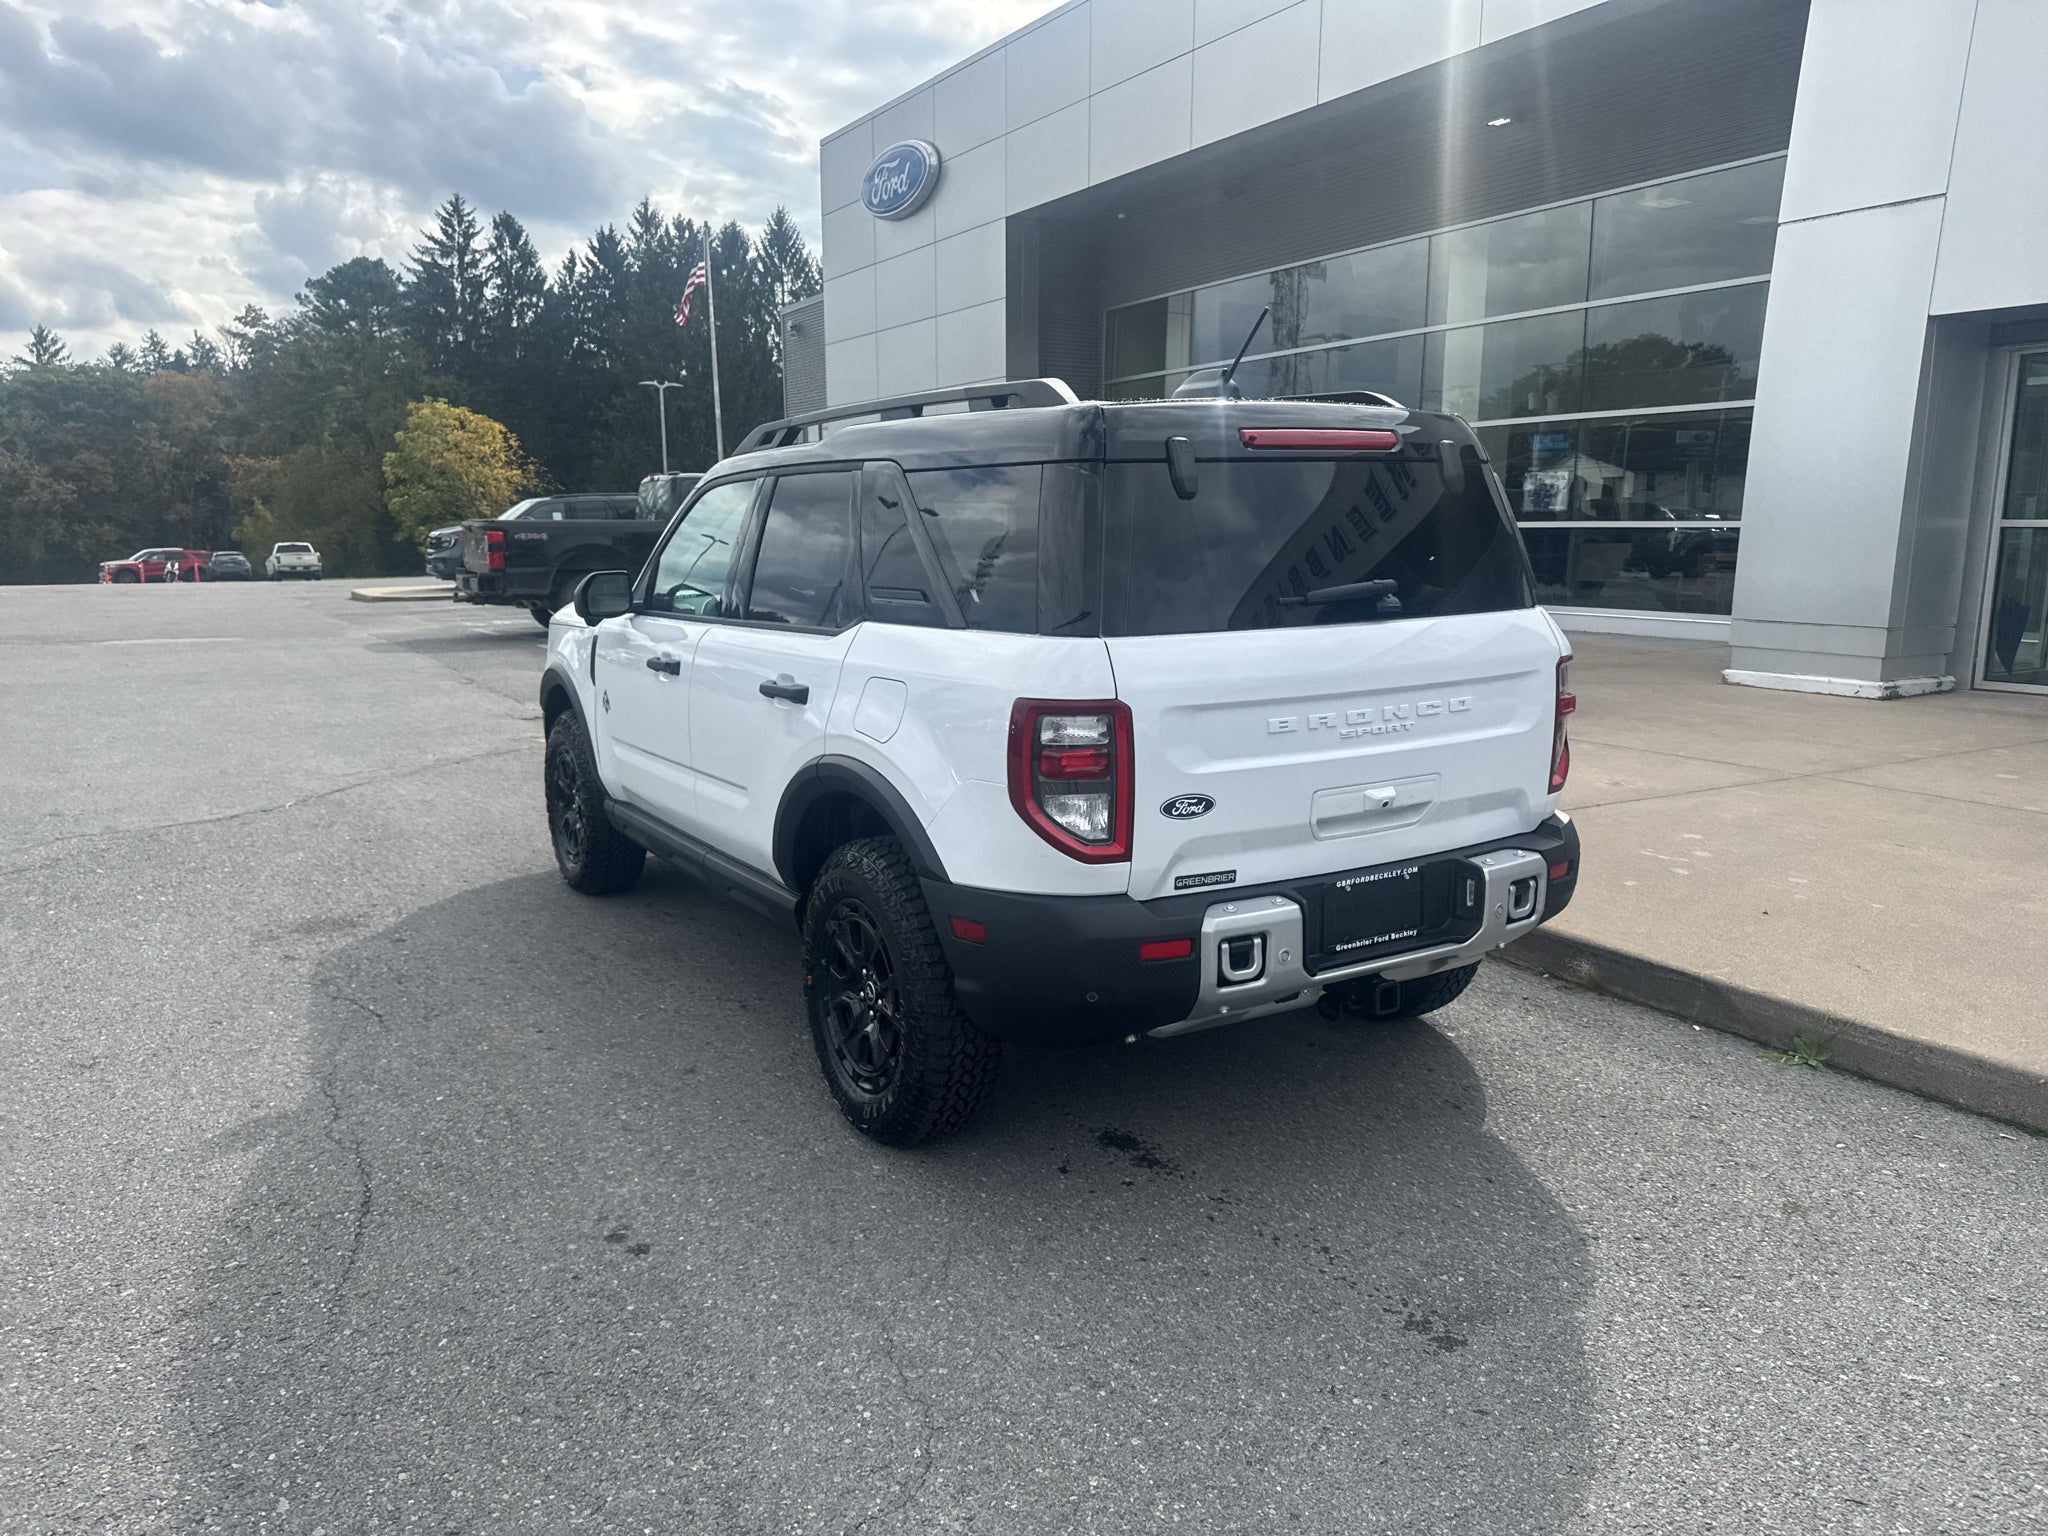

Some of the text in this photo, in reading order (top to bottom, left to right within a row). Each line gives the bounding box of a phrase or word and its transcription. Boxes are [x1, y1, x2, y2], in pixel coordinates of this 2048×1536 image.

[871, 158, 910, 205] Ford
[1267, 696, 1474, 734] BRONCO
[1340, 721, 1415, 739] SPORT
[1172, 799, 1206, 815] Ford
[1175, 873, 1235, 887] GREENBRIER
[1336, 866, 1419, 888] GBRFORDBECKLEY.COM
[1335, 929, 1418, 952] Greenbrier Ford Beckley
